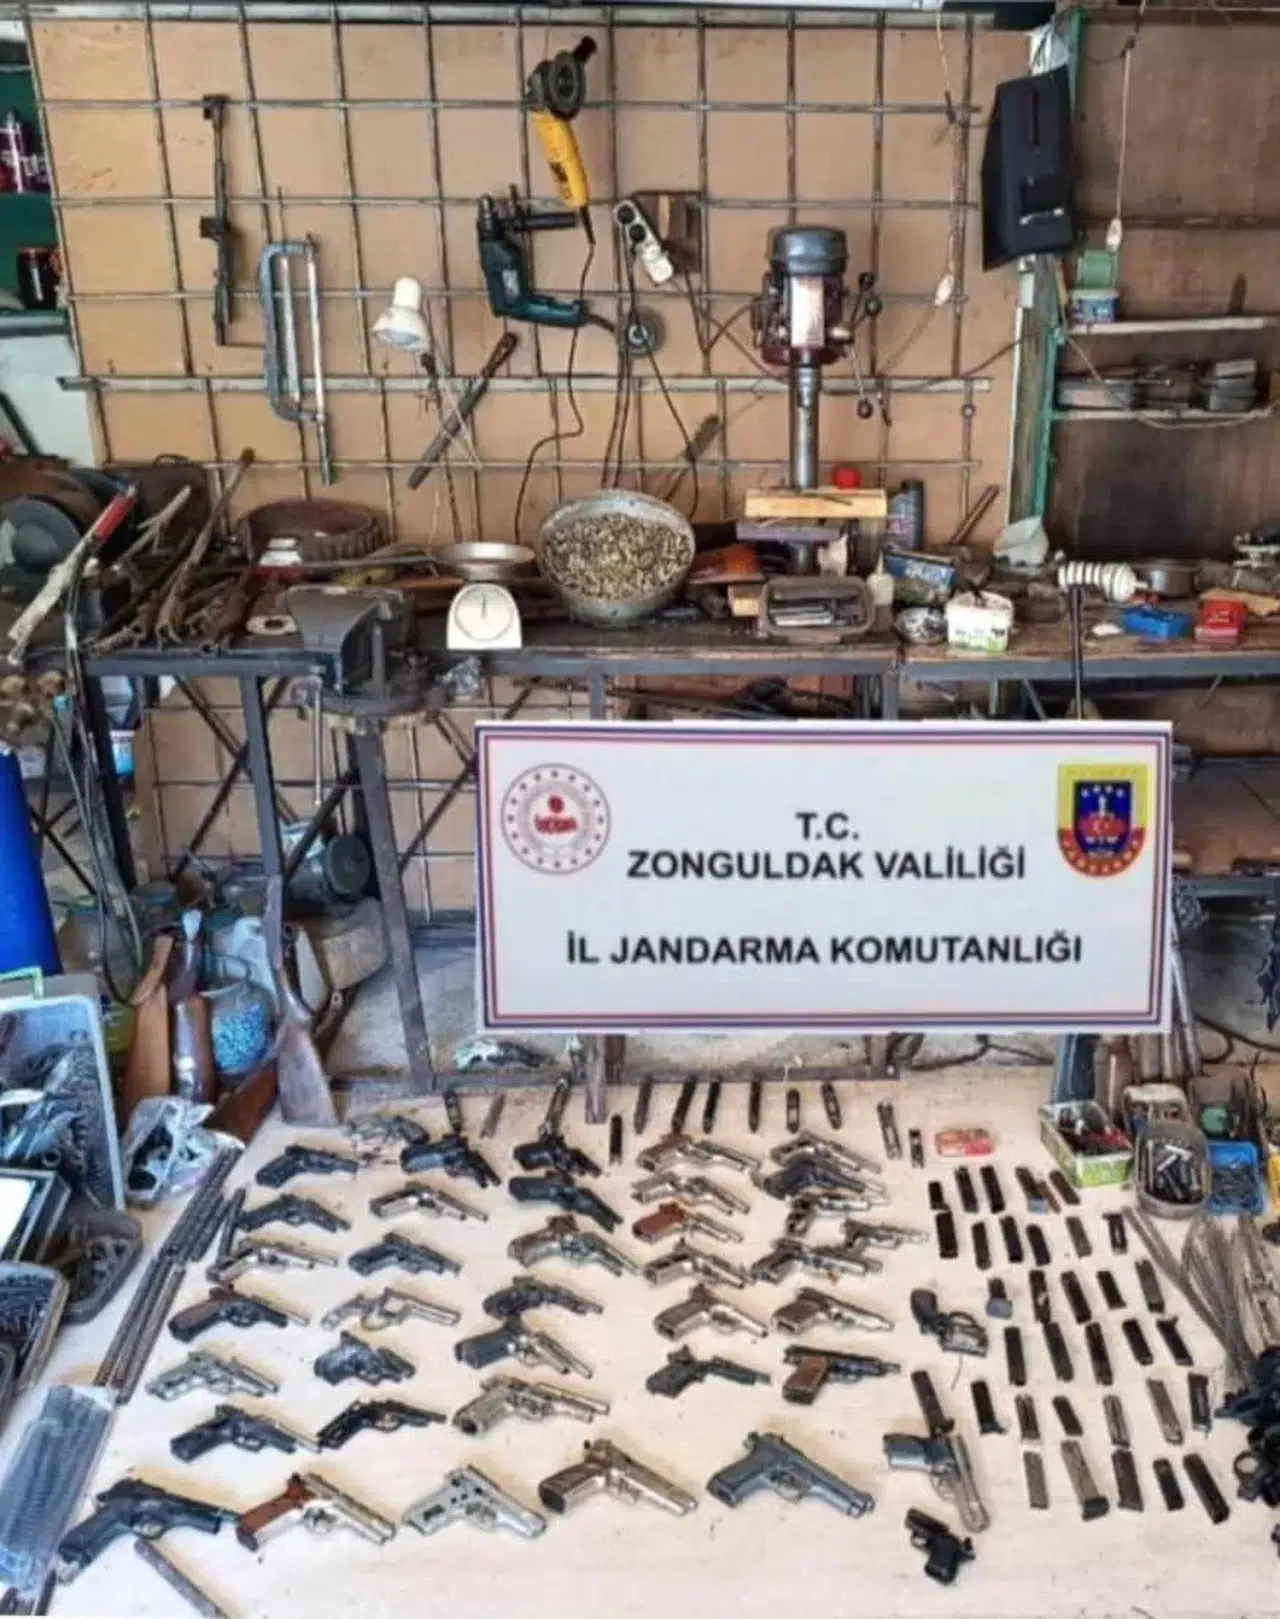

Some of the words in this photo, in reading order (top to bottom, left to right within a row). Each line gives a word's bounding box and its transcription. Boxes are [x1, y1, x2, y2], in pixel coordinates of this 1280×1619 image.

[796, 812, 859, 840] T.C.
[627, 850, 863, 880] ZONGULDAK
[874, 846, 1025, 879] VALİLİĞİ
[567, 931, 599, 964] İL
[610, 936, 820, 965] JANDARMA
[830, 931, 1083, 965] KOMUTANLIĞI
